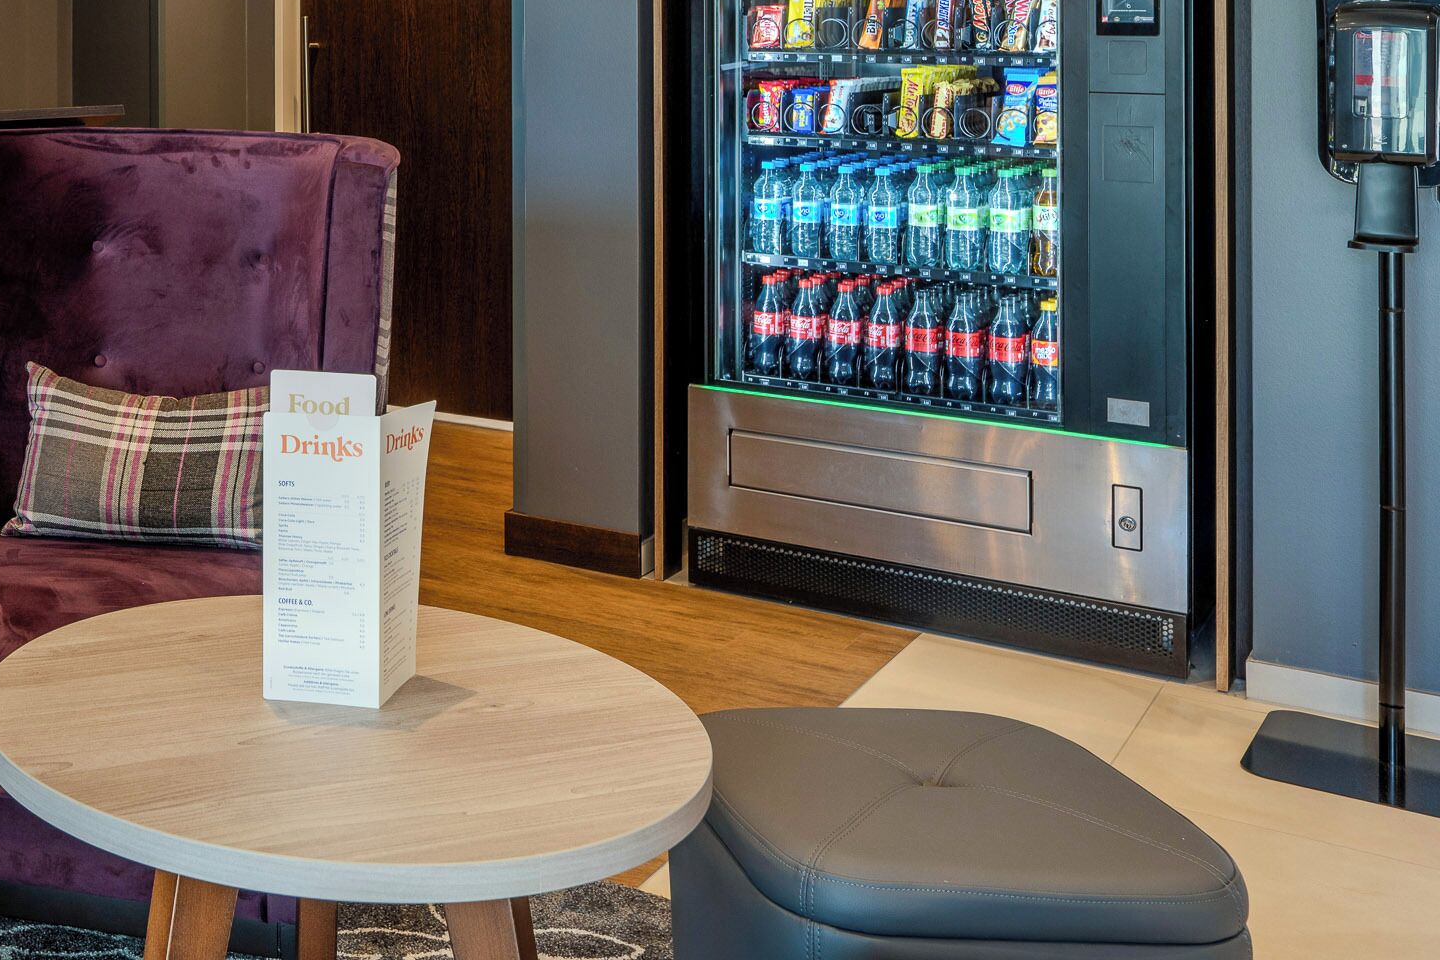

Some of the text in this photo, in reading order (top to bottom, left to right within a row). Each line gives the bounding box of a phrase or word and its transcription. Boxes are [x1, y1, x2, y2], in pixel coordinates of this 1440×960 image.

[288, 393, 351, 416] Food
[280, 434, 364, 463] Drinks
[386, 425, 425, 455] Drinks
[278, 597, 298, 605] COFFEE
